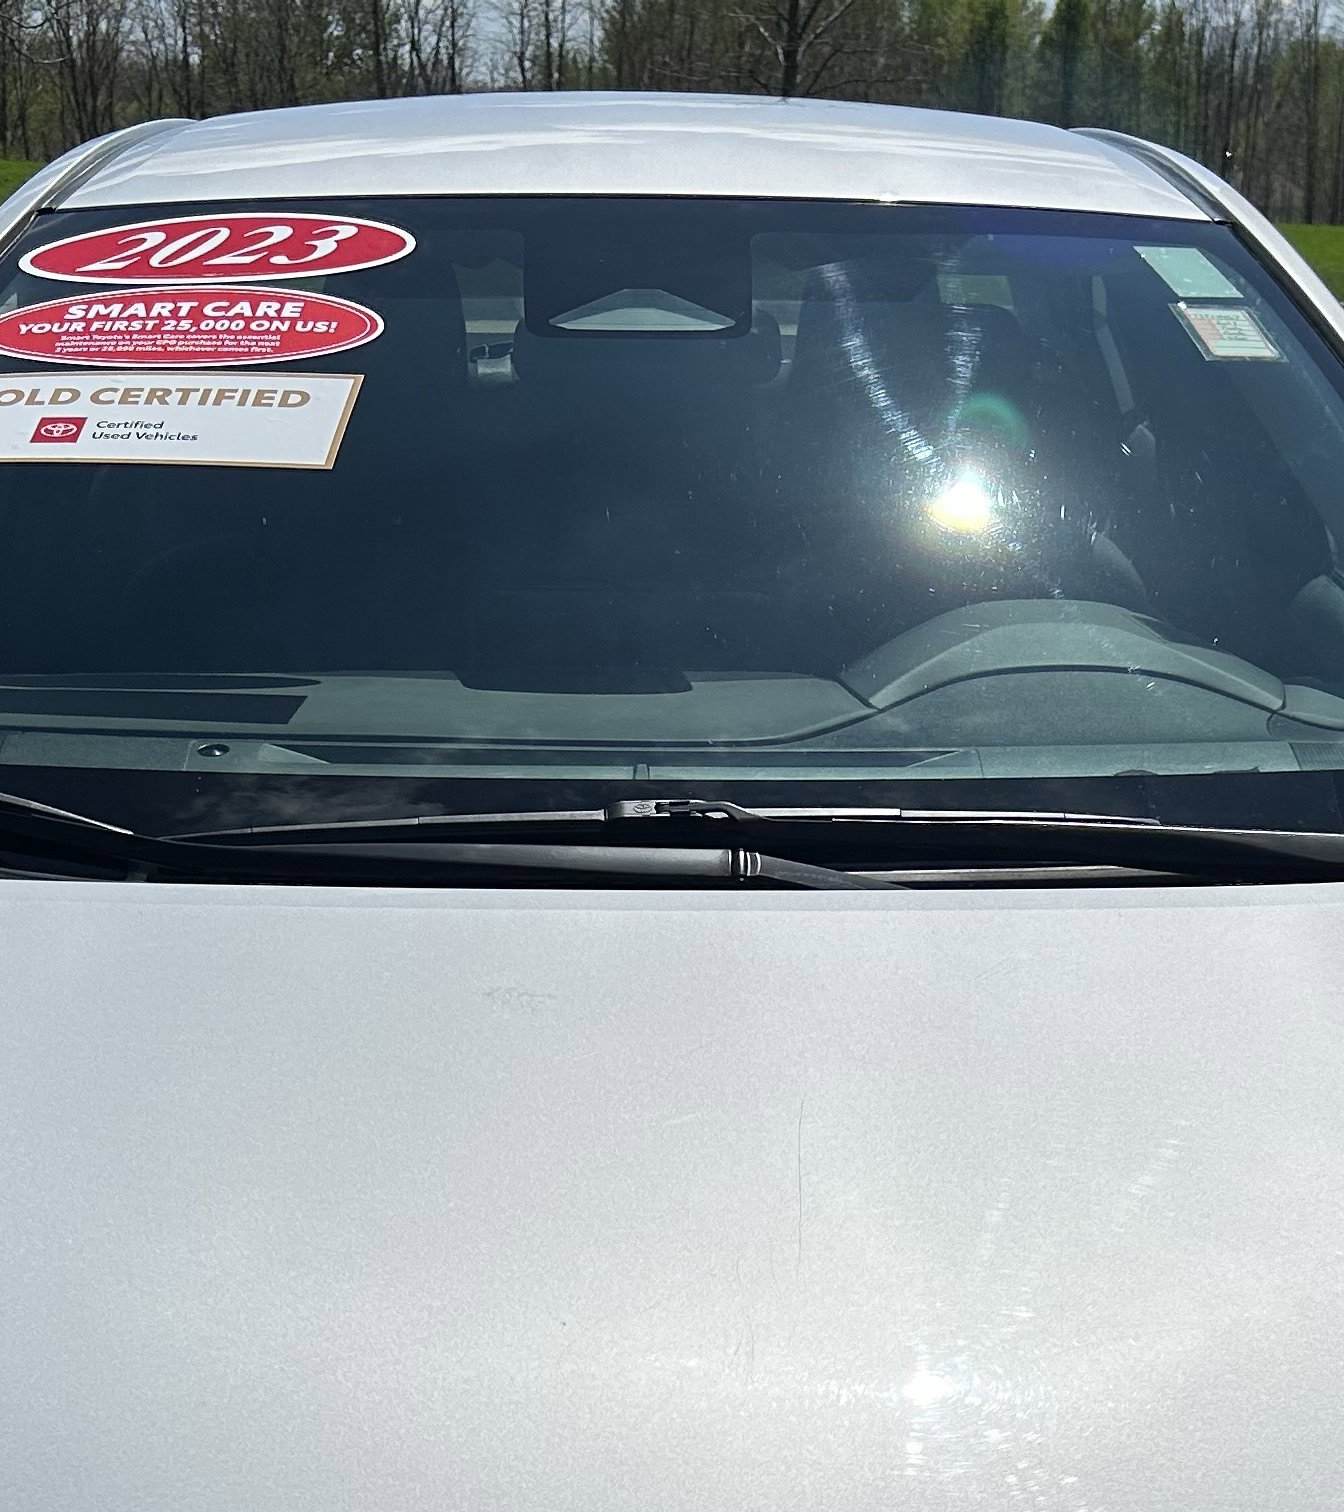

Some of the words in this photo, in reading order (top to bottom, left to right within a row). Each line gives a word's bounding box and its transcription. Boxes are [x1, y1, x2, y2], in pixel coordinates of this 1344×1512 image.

[75, 224, 359, 272] 2023
[63, 302, 202, 320] SMART
[202, 300, 305, 318] CARE
[18, 321, 86, 336] YOUR
[89, 320, 161, 333] FIRST
[161, 319, 246, 334] 25,000
[249, 319, 296, 333] ON
[295, 321, 339, 333] US!
[89, 387, 312, 408] CERTIFIED
[96, 419, 164, 430] Certified
[92, 430, 133, 441] Used
[135, 431, 199, 442] Vehicles
